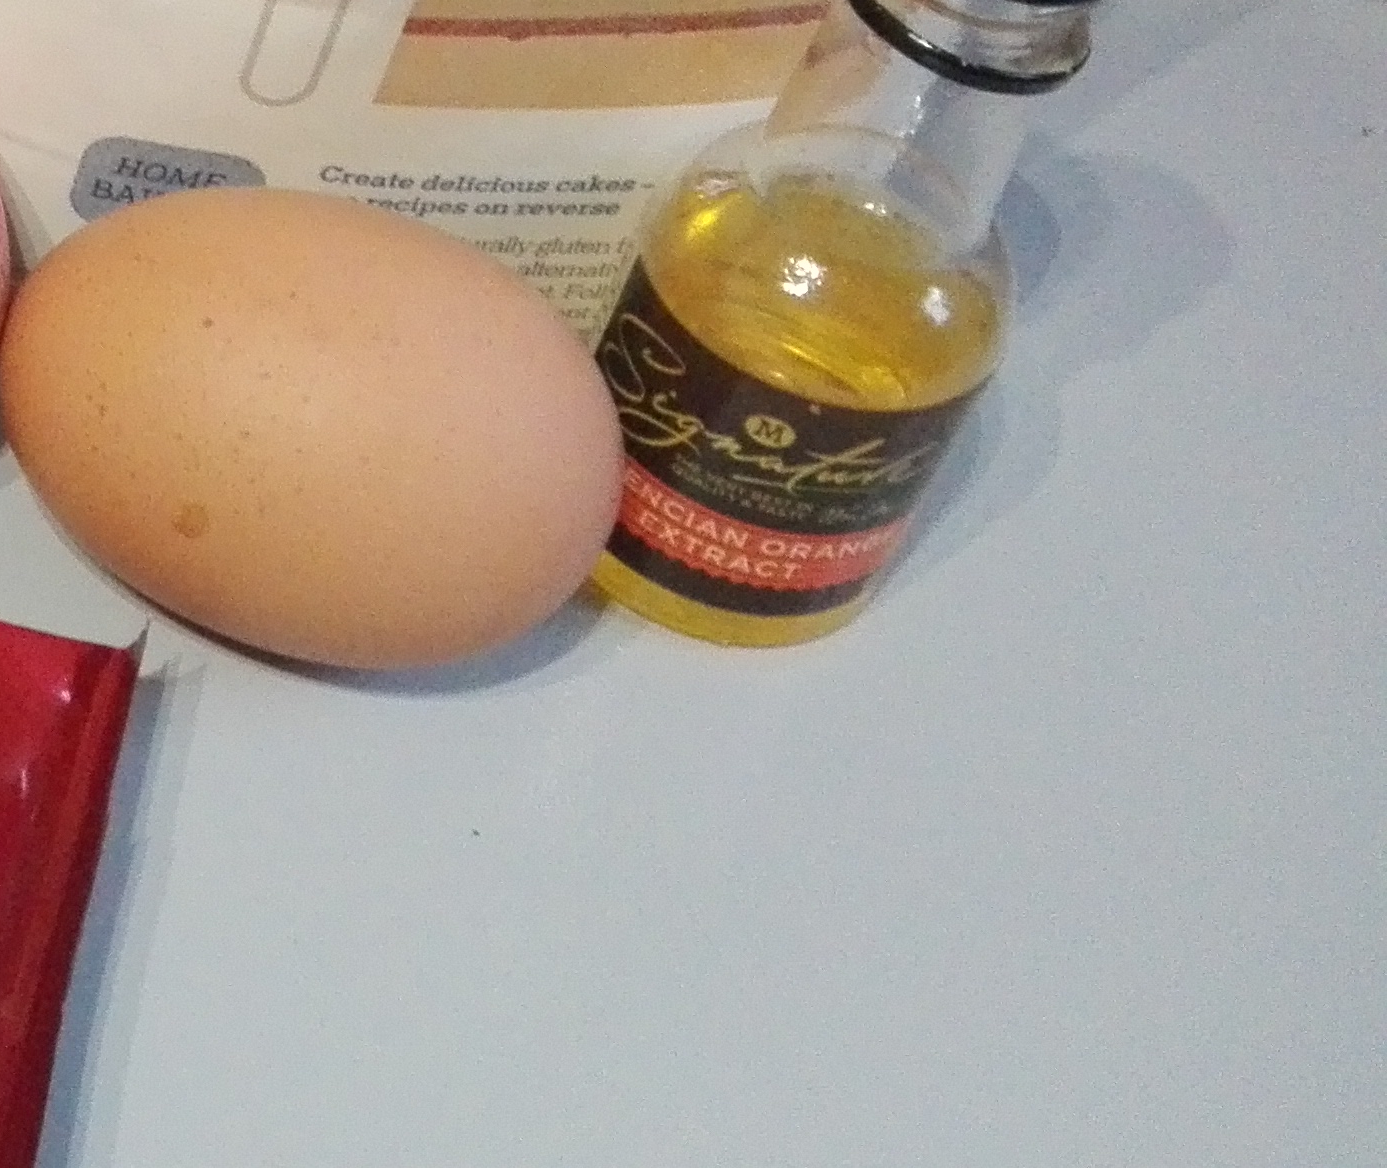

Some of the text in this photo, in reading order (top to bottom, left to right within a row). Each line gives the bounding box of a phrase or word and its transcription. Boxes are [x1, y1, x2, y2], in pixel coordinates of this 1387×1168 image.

[319, 164, 629, 196] Create delicious cakes
[368, 198, 621, 218] recipes on reverse
[626, 471, 752, 553] ENCIAN
[638, 510, 805, 581] EXTRACT
